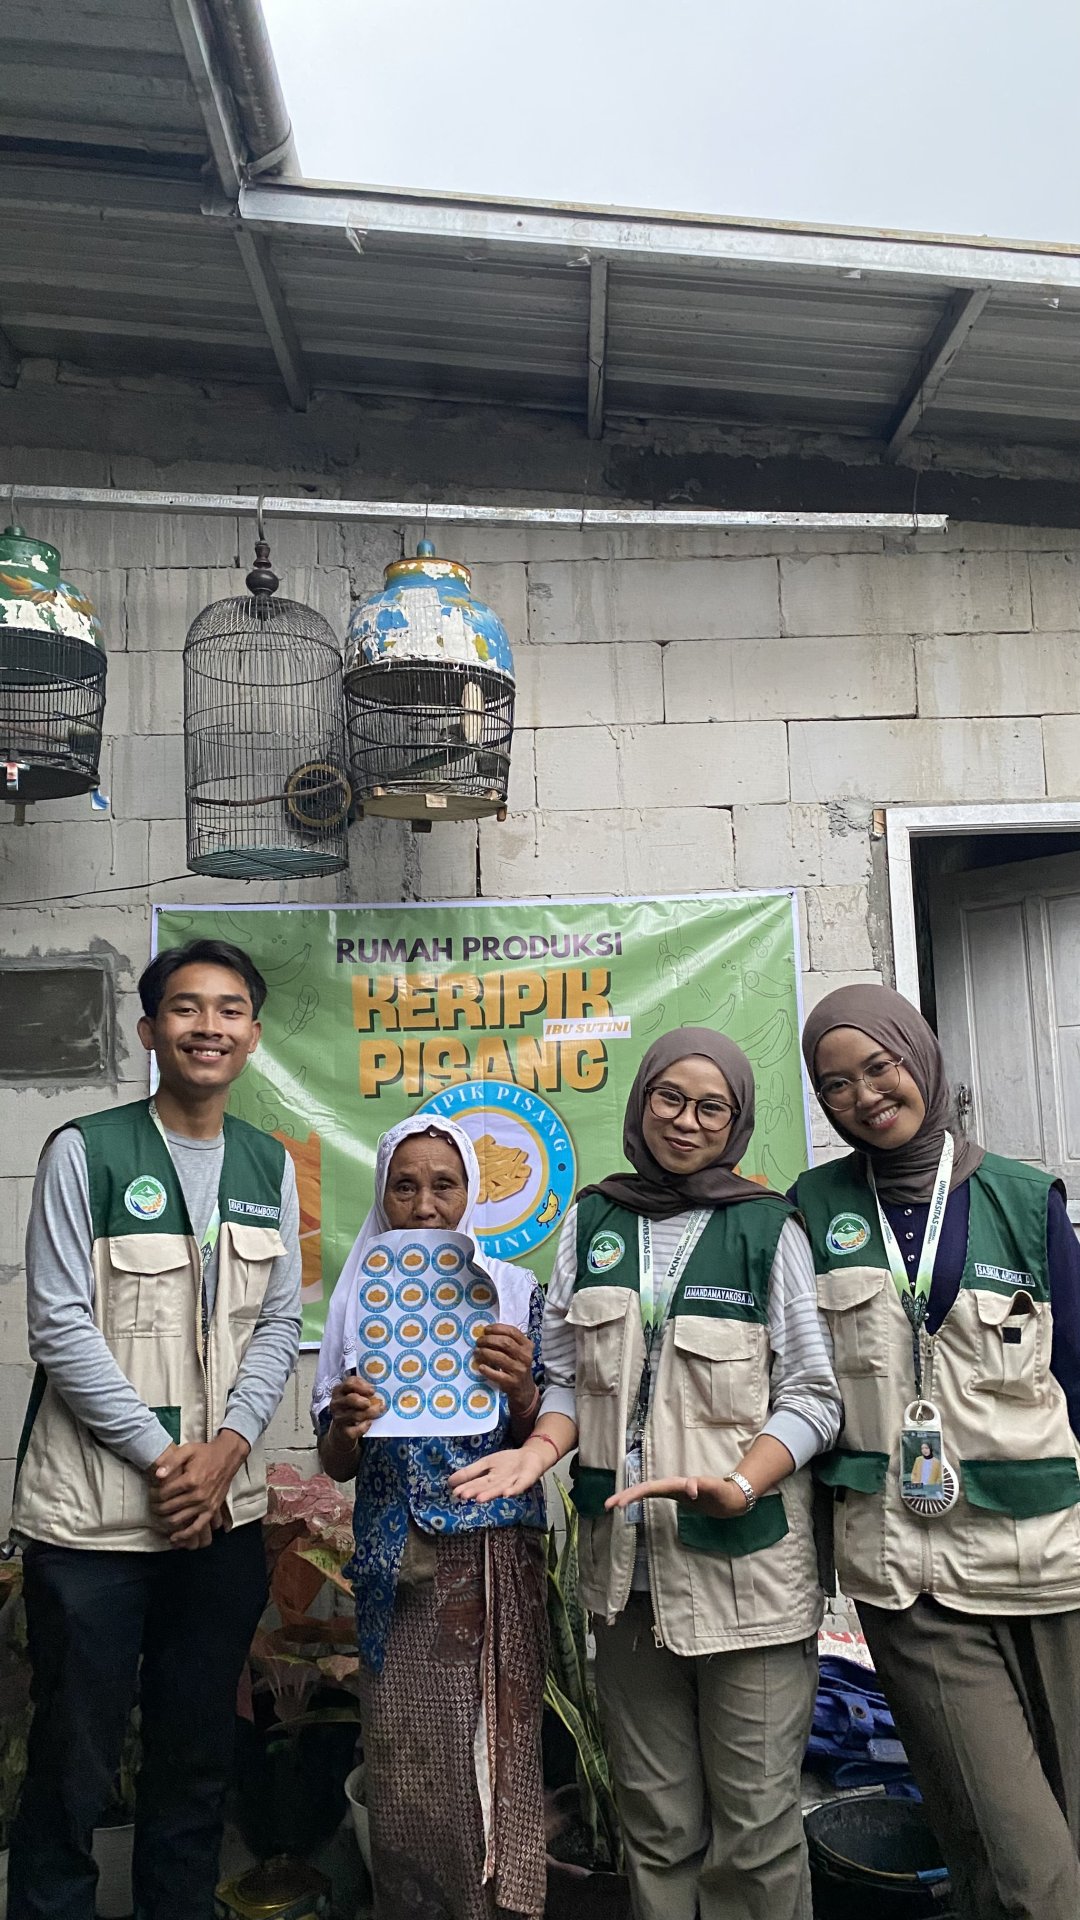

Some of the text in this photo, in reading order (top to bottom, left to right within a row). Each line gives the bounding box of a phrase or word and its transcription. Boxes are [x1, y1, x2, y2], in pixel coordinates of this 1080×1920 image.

[336, 931, 623, 963] RUMAH PRODUKSI
[351, 967, 613, 1032] KERIPIK
[545, 1020, 631, 1035] IBU SUTINI
[358, 1036, 608, 1099] PISANG
[496, 1086, 568, 1153] PISANG
[931, 1180, 947, 1225] UNIVERSITAS
[667, 1257, 681, 1278] KKN
[977, 1265, 1000, 1279] SASKIA
